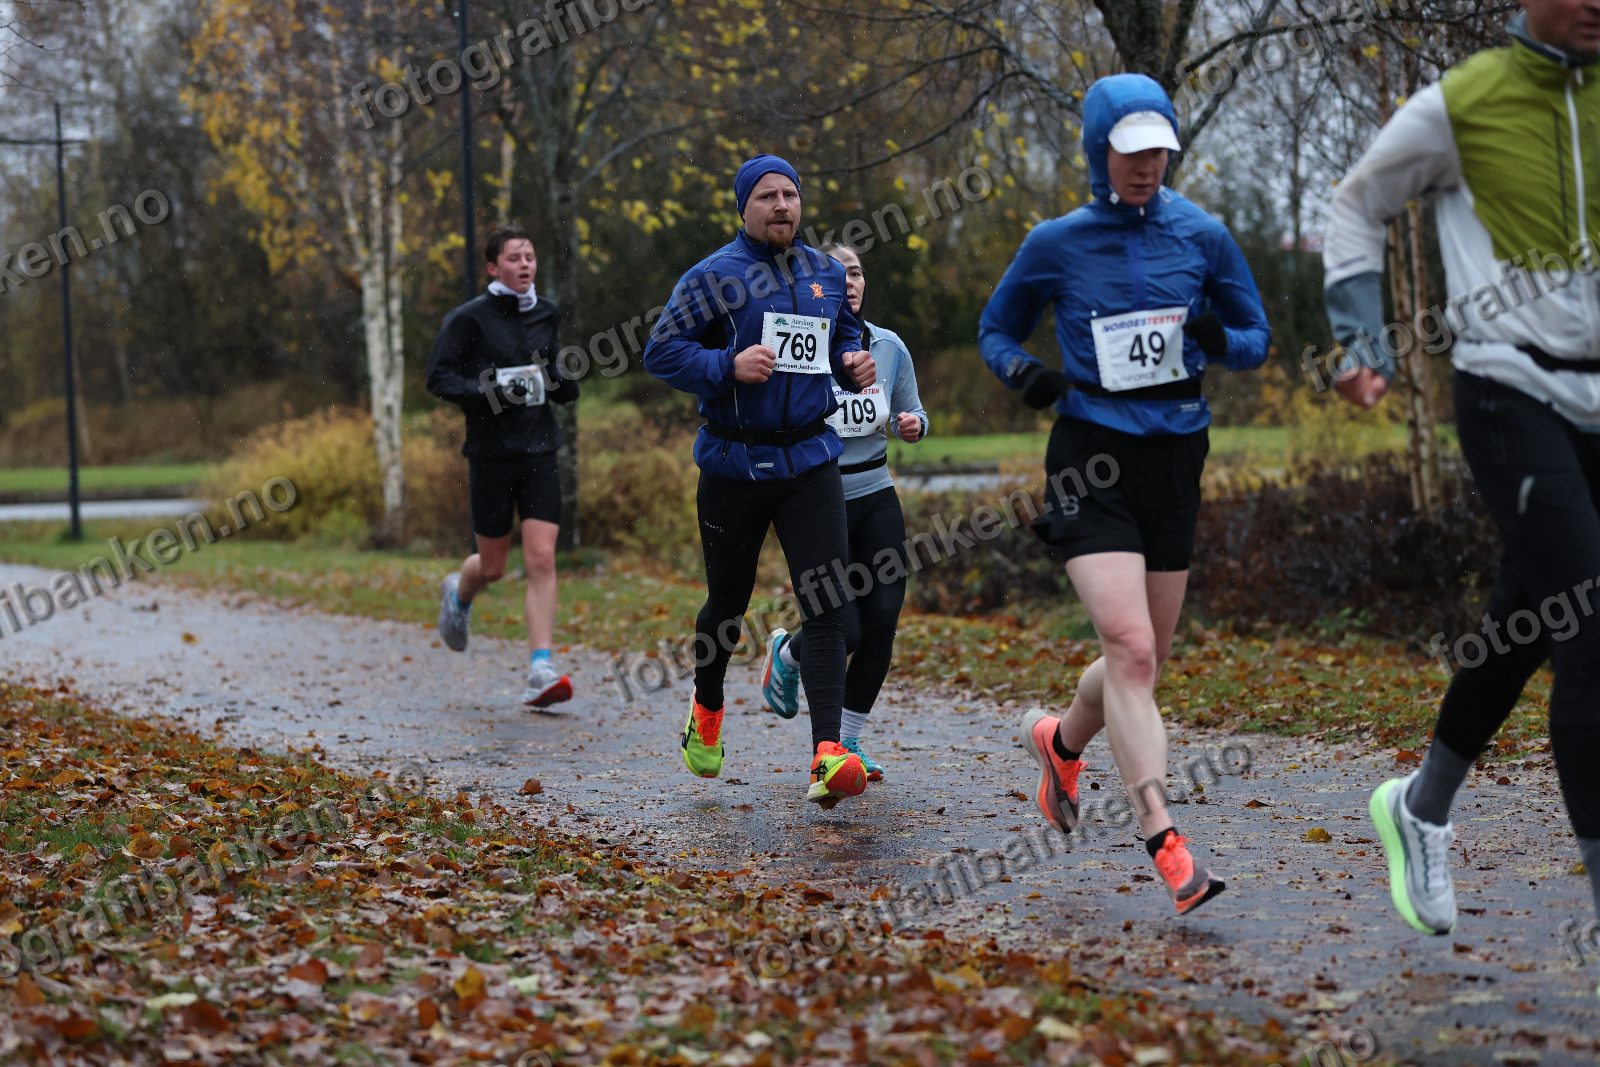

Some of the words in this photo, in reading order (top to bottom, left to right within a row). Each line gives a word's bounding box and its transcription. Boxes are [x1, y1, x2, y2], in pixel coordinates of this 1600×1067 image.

[776, 331, 816, 362] 769
[1129, 331, 1165, 367] 49
[837, 398, 877, 425] 109
